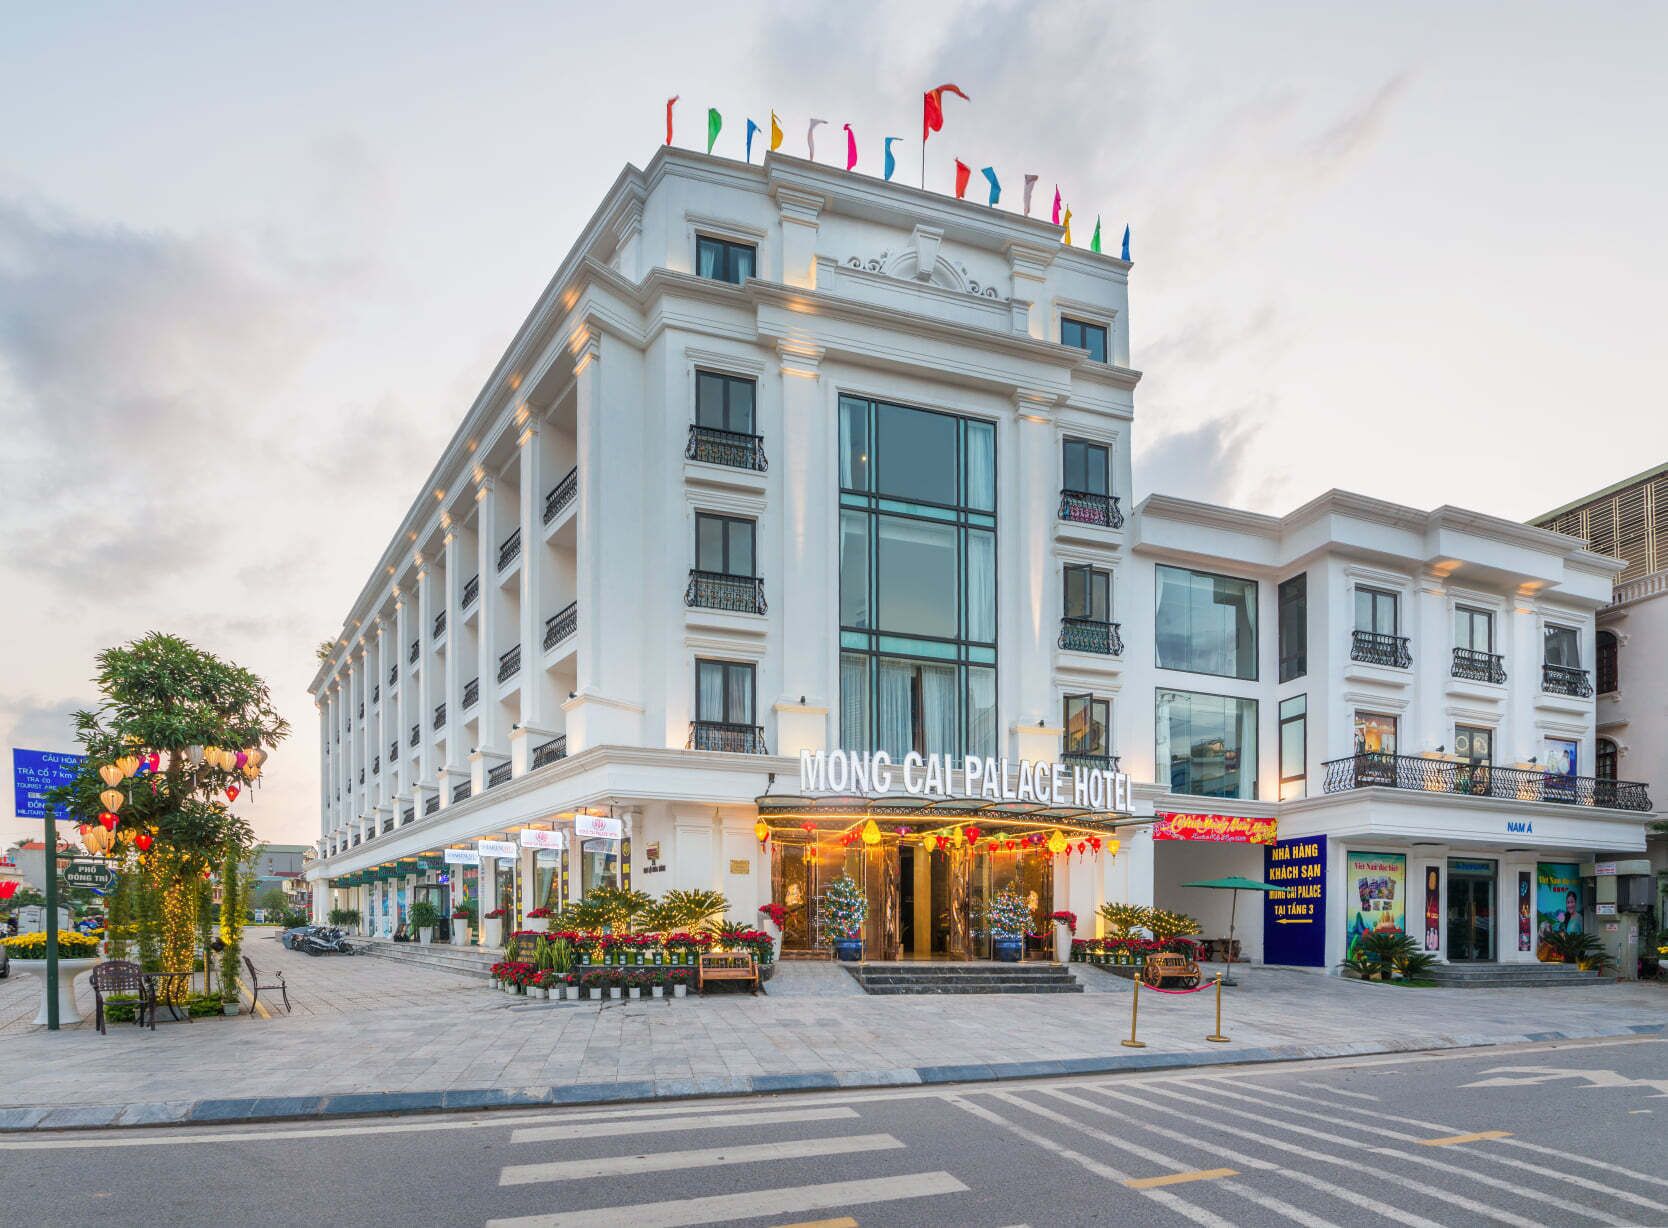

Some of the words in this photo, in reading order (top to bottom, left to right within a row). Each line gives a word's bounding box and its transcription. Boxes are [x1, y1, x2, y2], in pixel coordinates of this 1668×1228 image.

[59, 770, 73, 779] km
[800, 750, 891, 793] MONG
[903, 750, 952, 796] CAI
[965, 755, 1066, 804] PALACE
[1075, 765, 1137, 812] HOTEL
[1507, 822, 1526, 833] NAM
[1272, 844, 1290, 860] NHÀ
[1292, 842, 1319, 859] HÀNG
[1269, 864, 1299, 880] KHÁCH
[1301, 863, 1321, 880] SẠN
[1298, 884, 1322, 899] PALACE
[1274, 905, 1286, 917] TẠI
[1309, 904, 1314, 914] 3
